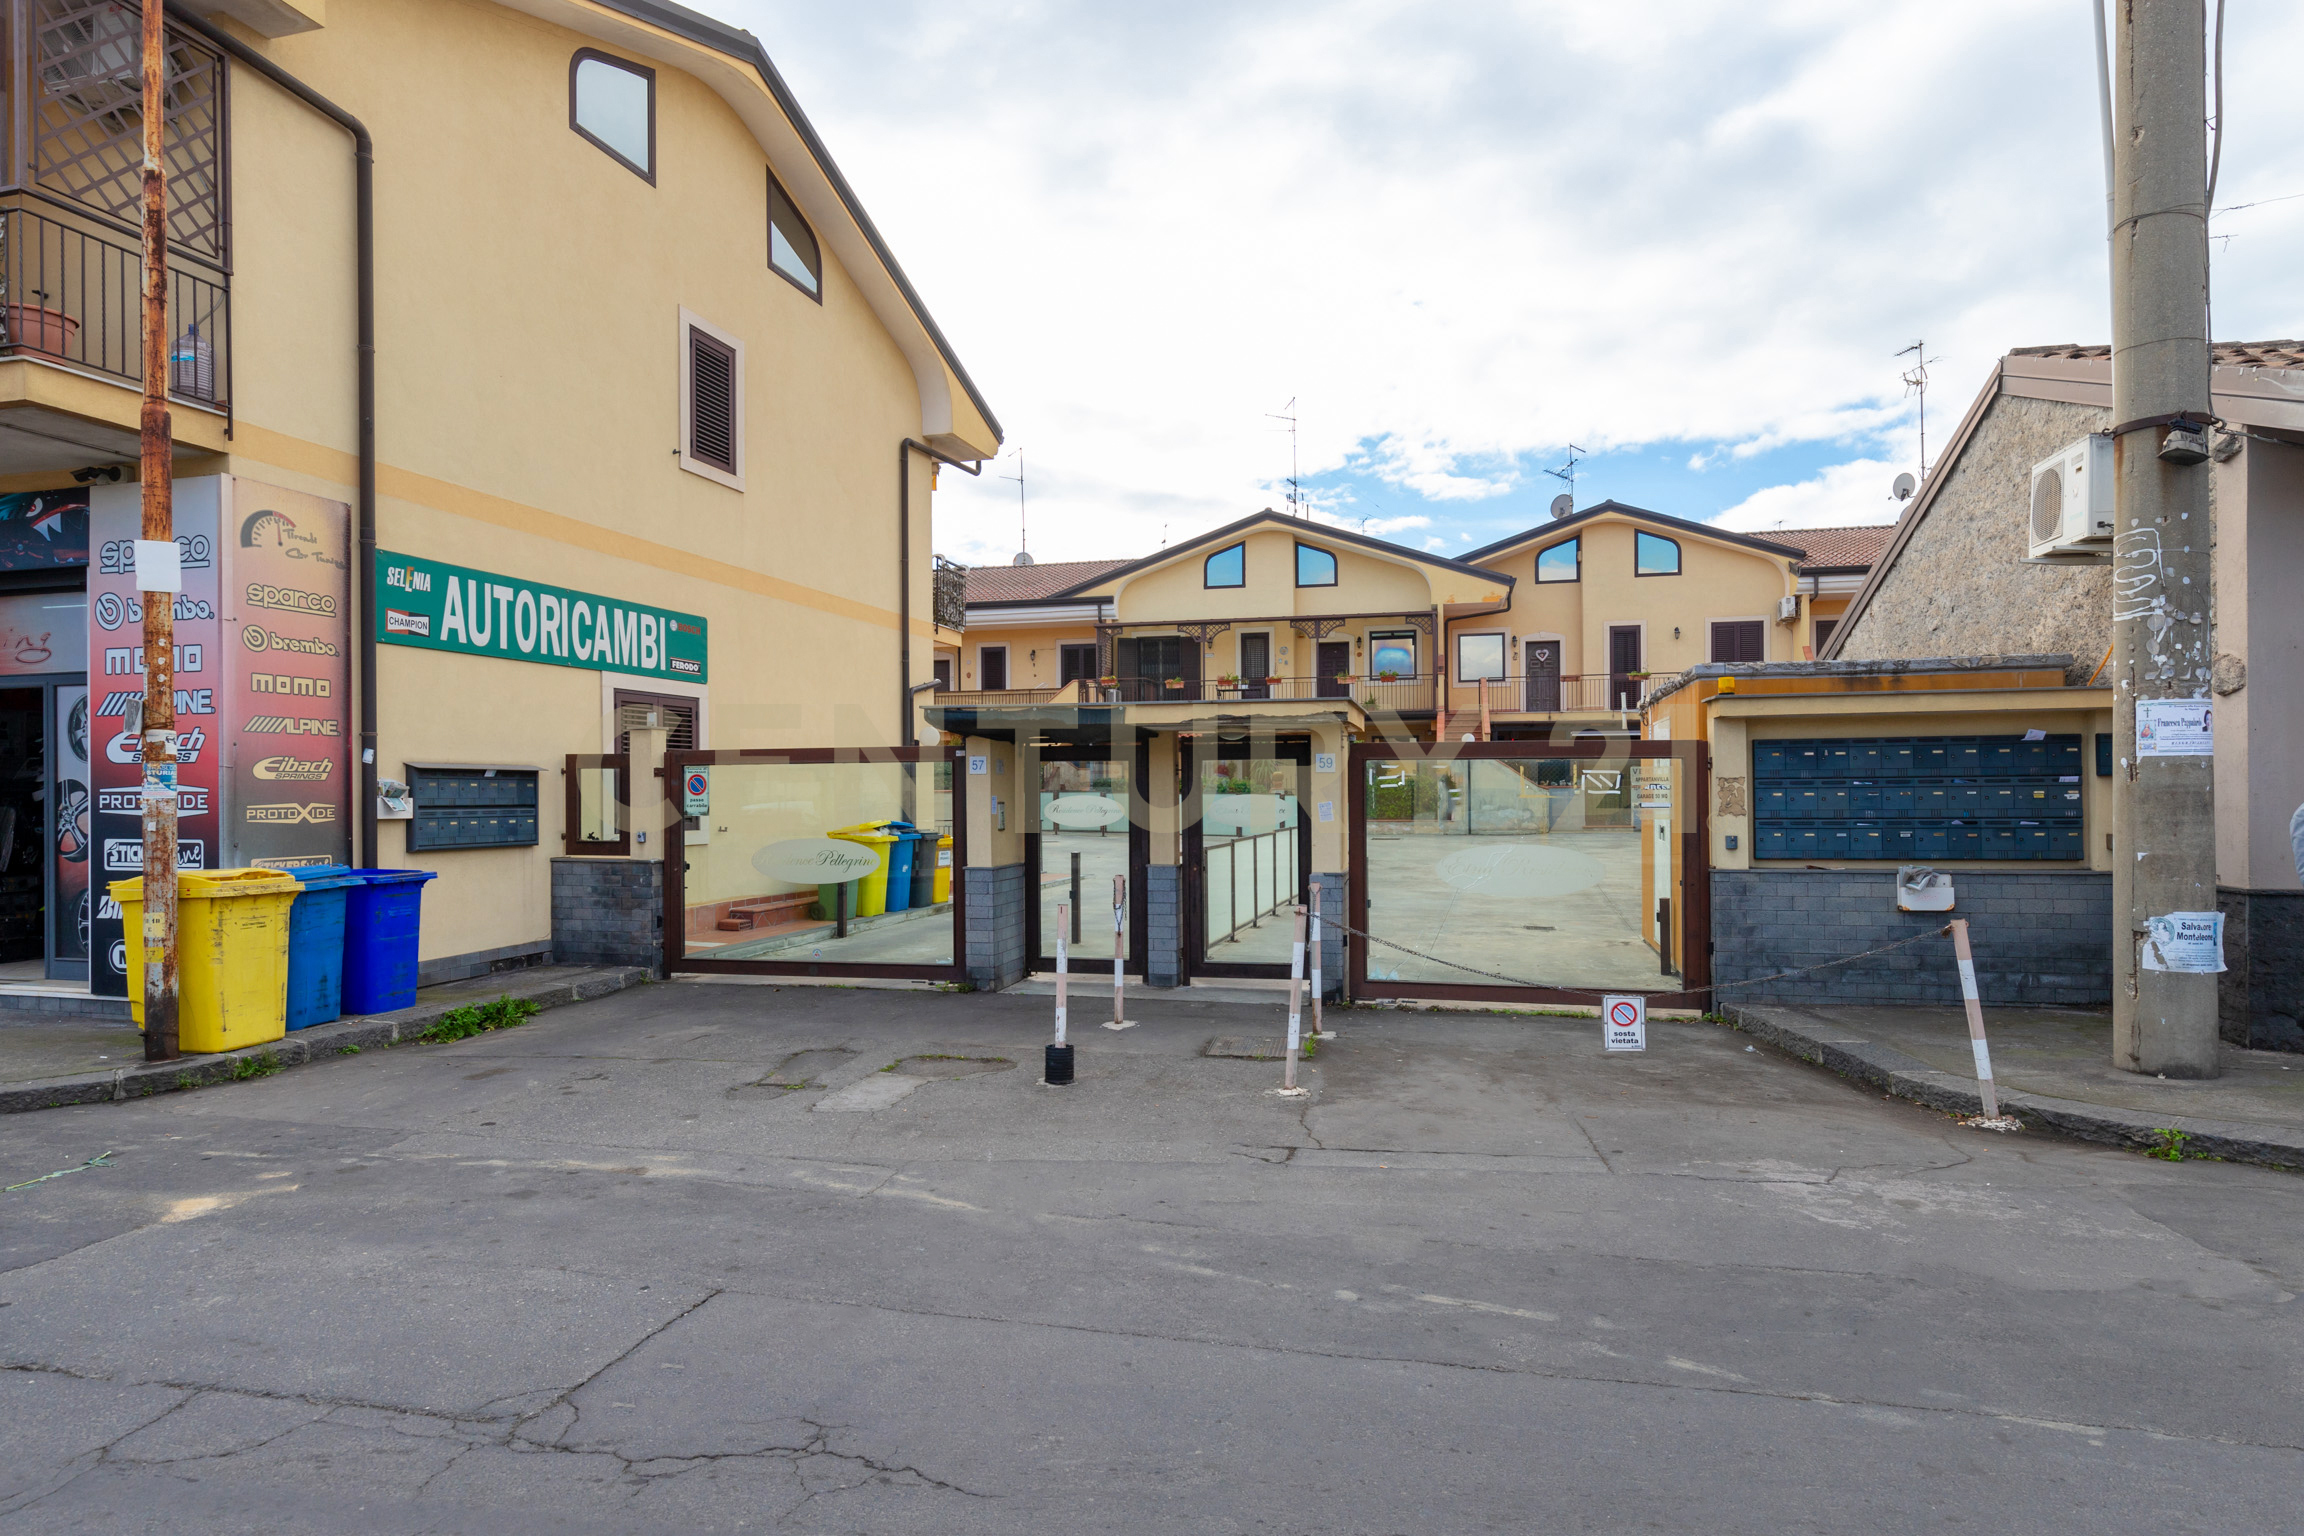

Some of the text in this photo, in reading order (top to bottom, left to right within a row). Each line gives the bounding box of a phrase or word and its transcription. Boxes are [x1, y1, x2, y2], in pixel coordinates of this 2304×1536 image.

[101, 535, 210, 574] spco
[386, 566, 431, 592] SELENIA
[246, 583, 336, 614] sparco
[388, 616, 428, 630] CHAMPION
[440, 575, 666, 671] AUTORICAMBI
[678, 622, 701, 635] BOSCH
[269, 632, 337, 656] brembo
[671, 660, 699, 672] FERODO
[251, 672, 331, 698] momo
[274, 716, 339, 737] ALPINE
[253, 755, 333, 776] Eibach
[972, 760, 984, 771] 57
[1319, 757, 1333, 769] 59
[100, 792, 208, 811] PROIDE
[247, 805, 334, 822] PROTOXIDE
